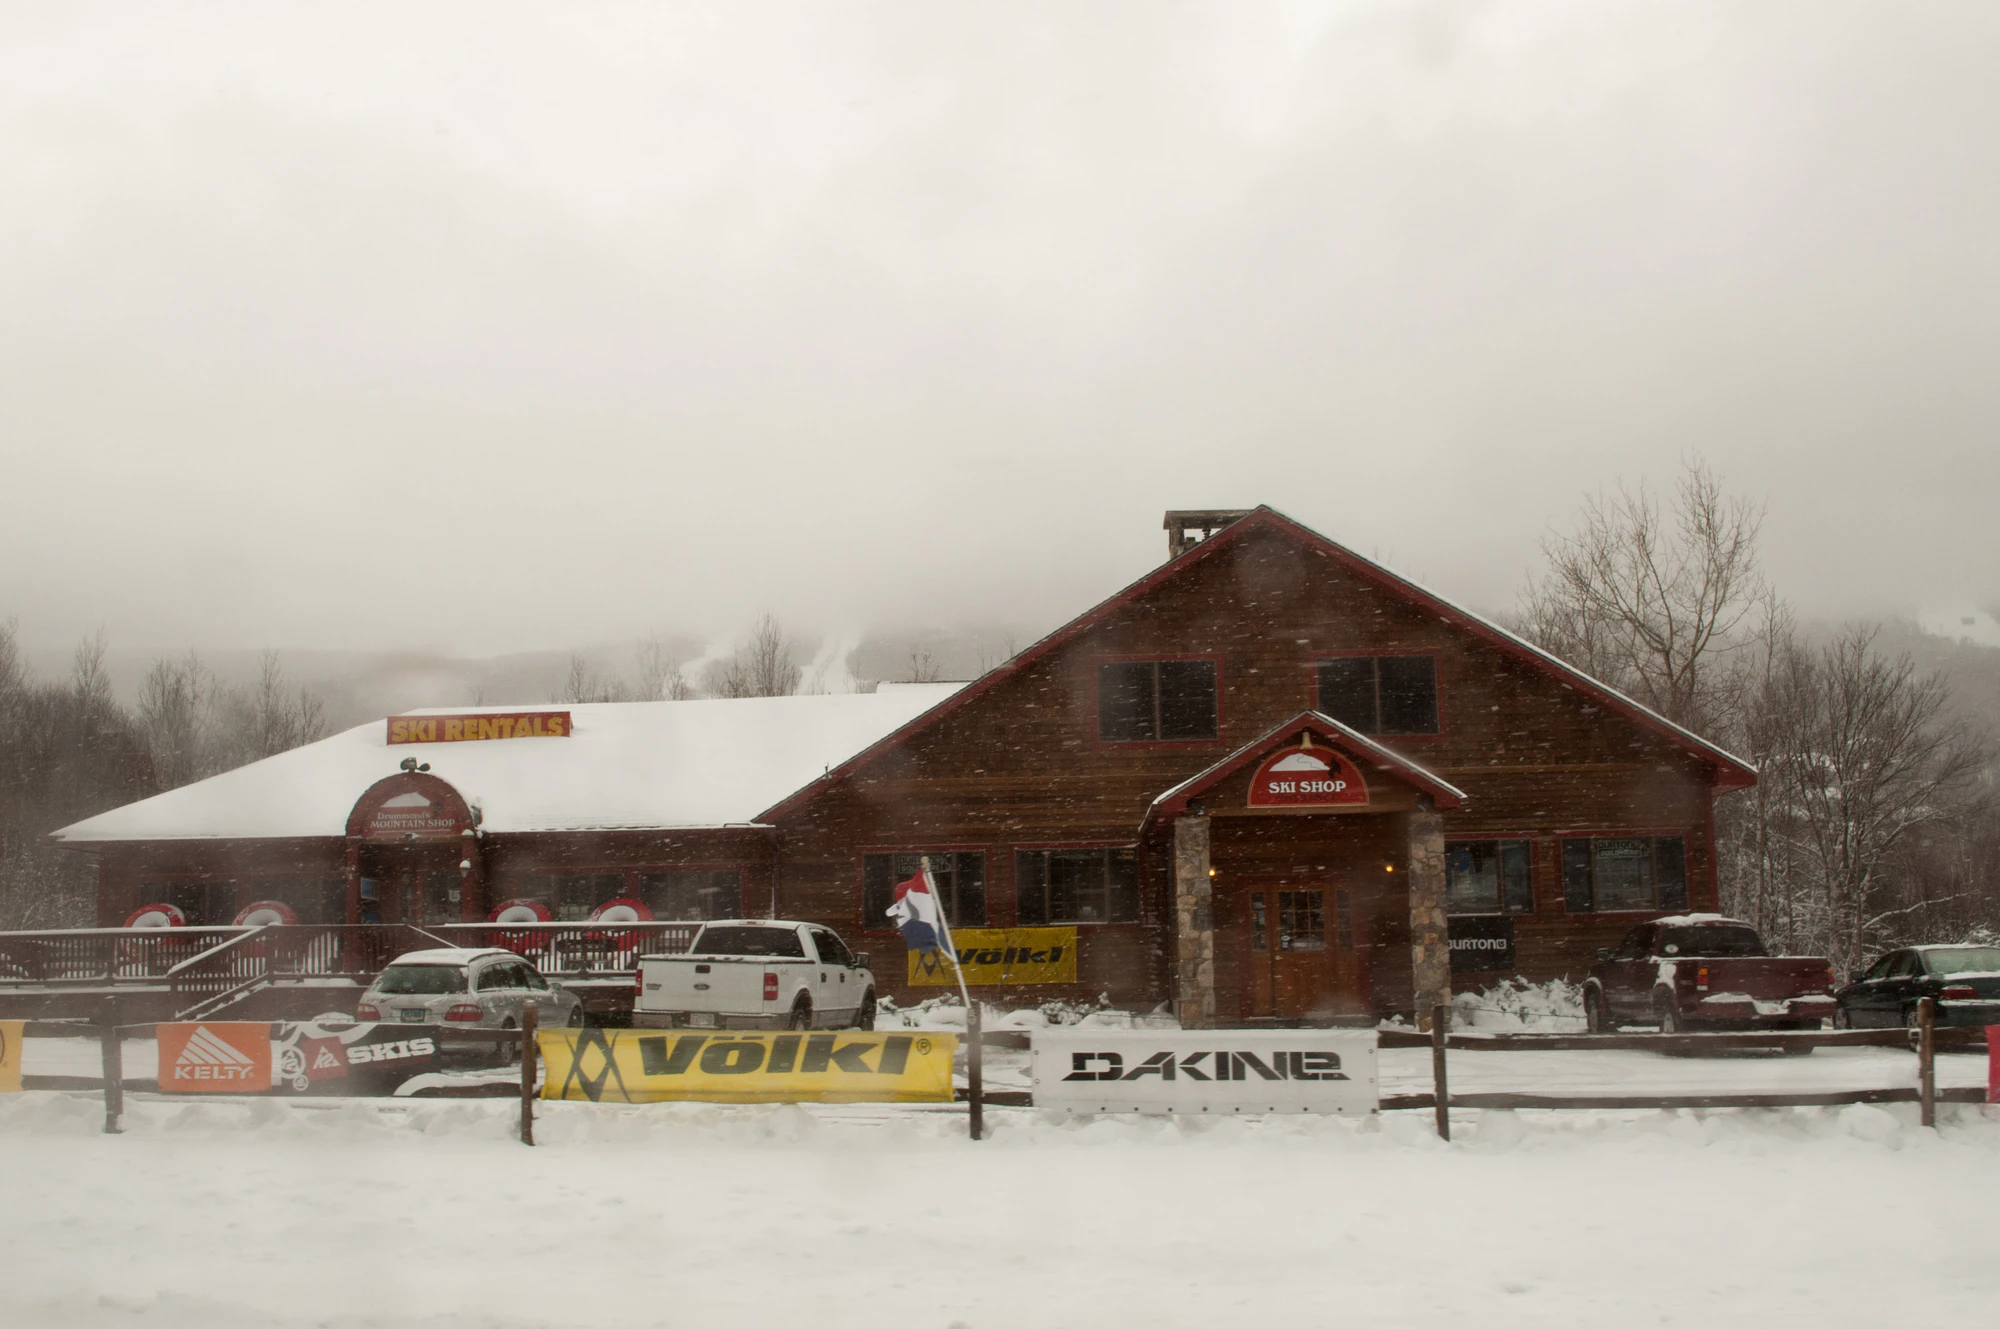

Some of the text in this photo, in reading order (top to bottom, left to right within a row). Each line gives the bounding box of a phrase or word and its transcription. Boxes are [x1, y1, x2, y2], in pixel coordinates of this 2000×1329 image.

[391, 716, 564, 743] SKI RENTALS
[1268, 780, 1347, 794] SKI SHOP
[370, 818, 456, 829] MOUNTAIN SHOP
[377, 811, 431, 820] Drummond's
[347, 1037, 436, 1064] SKIS
[638, 1034, 914, 1076] Völkl
[174, 1065, 254, 1080] KELTY
[1061, 1051, 1352, 1081] DAKINE
